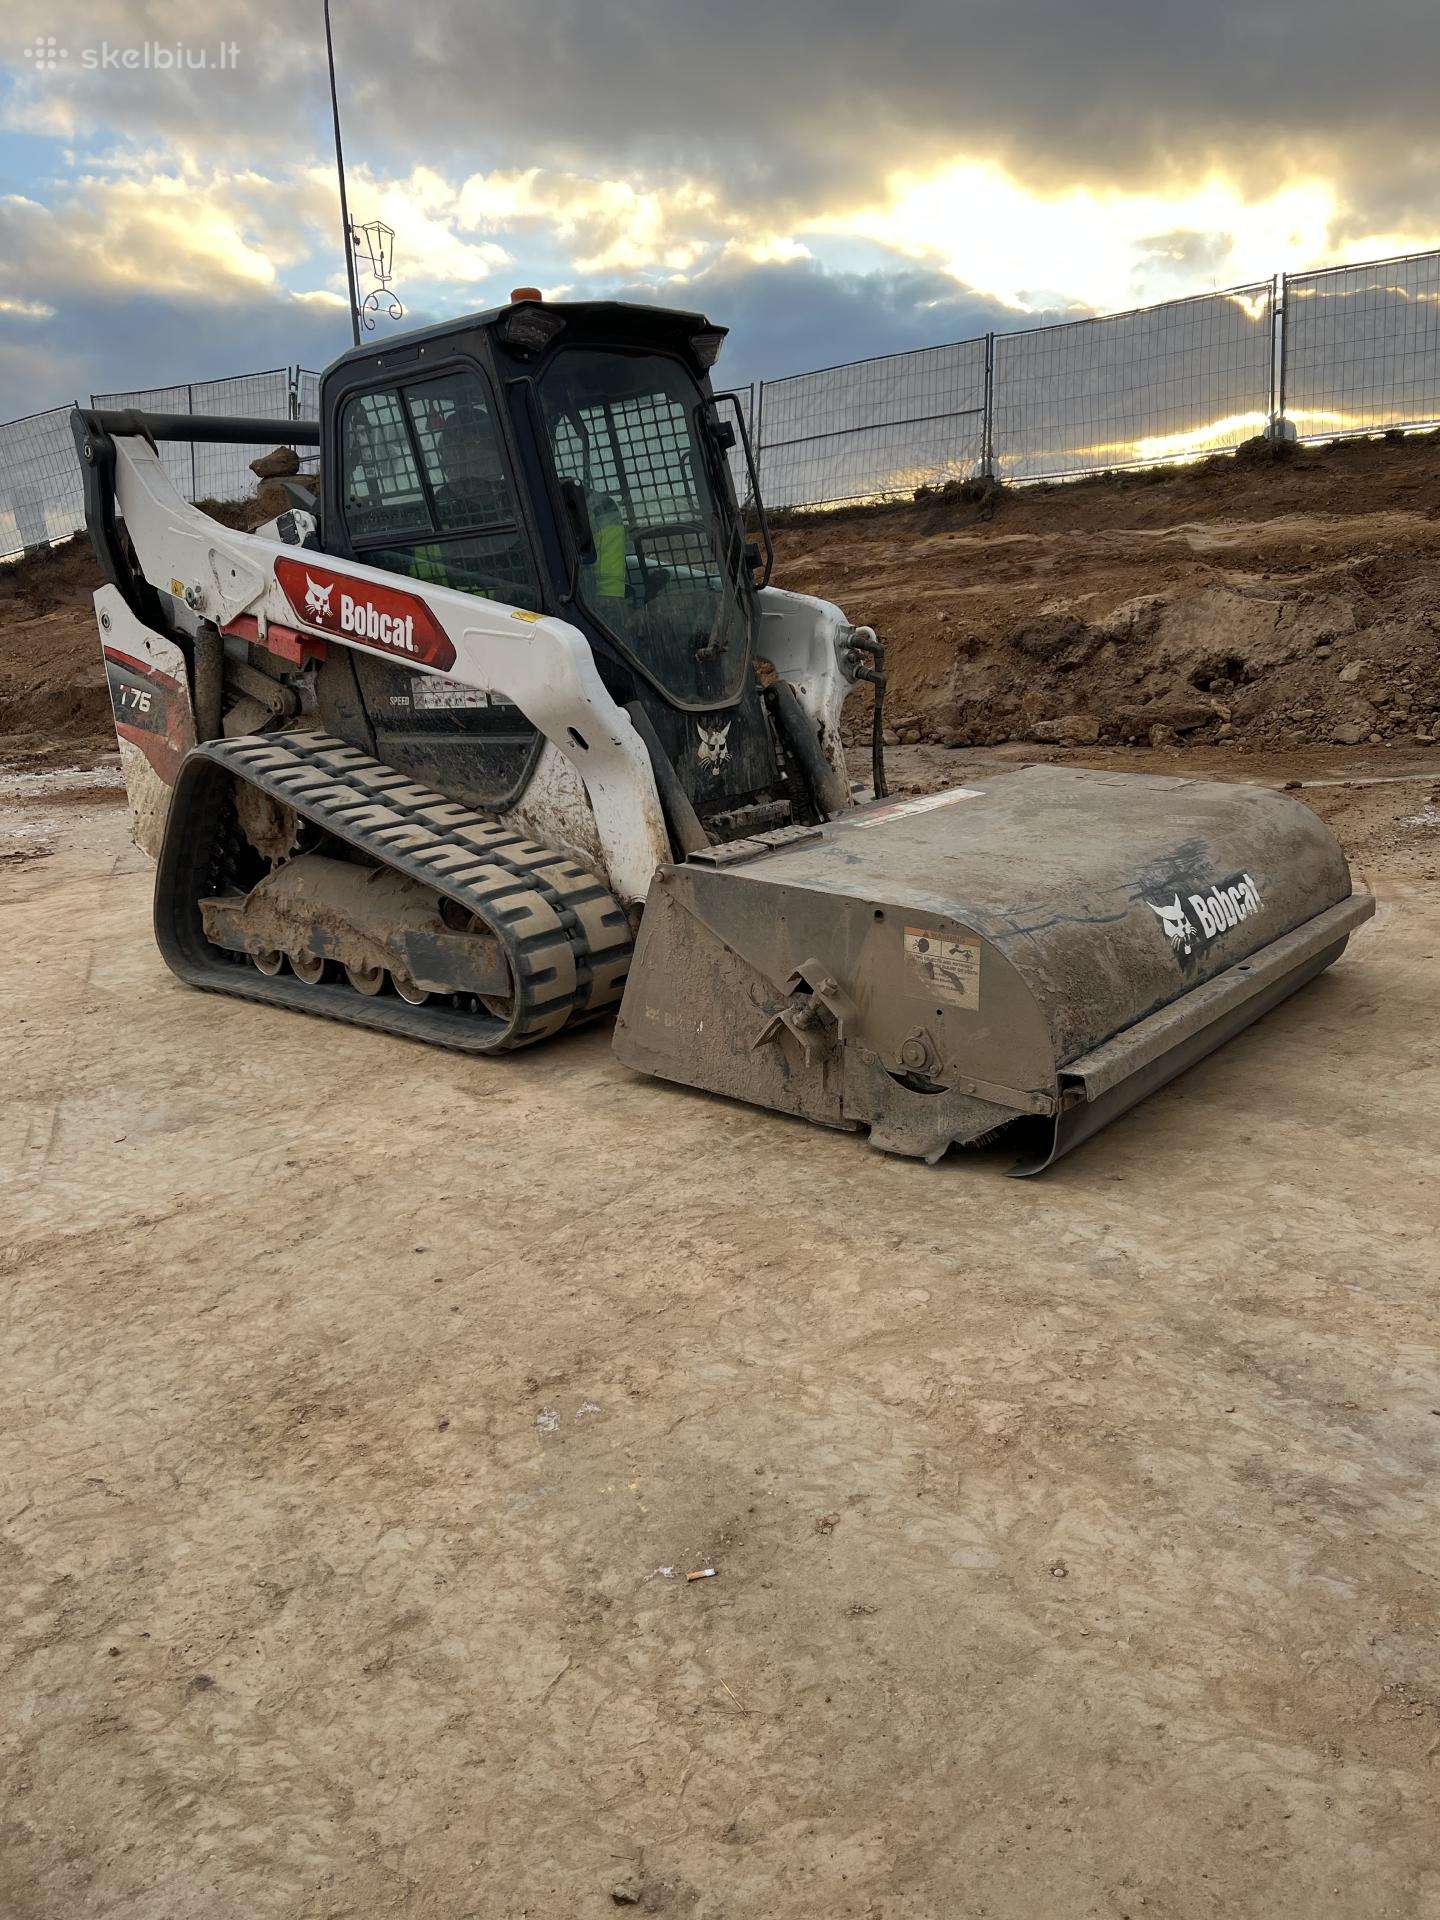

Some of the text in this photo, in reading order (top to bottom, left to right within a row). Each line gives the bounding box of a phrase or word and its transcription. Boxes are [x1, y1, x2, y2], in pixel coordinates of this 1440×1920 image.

[340, 594, 415, 652] Bobcat
[389, 696, 410, 706] SPEED
[1188, 873, 1261, 939] Bobcat
